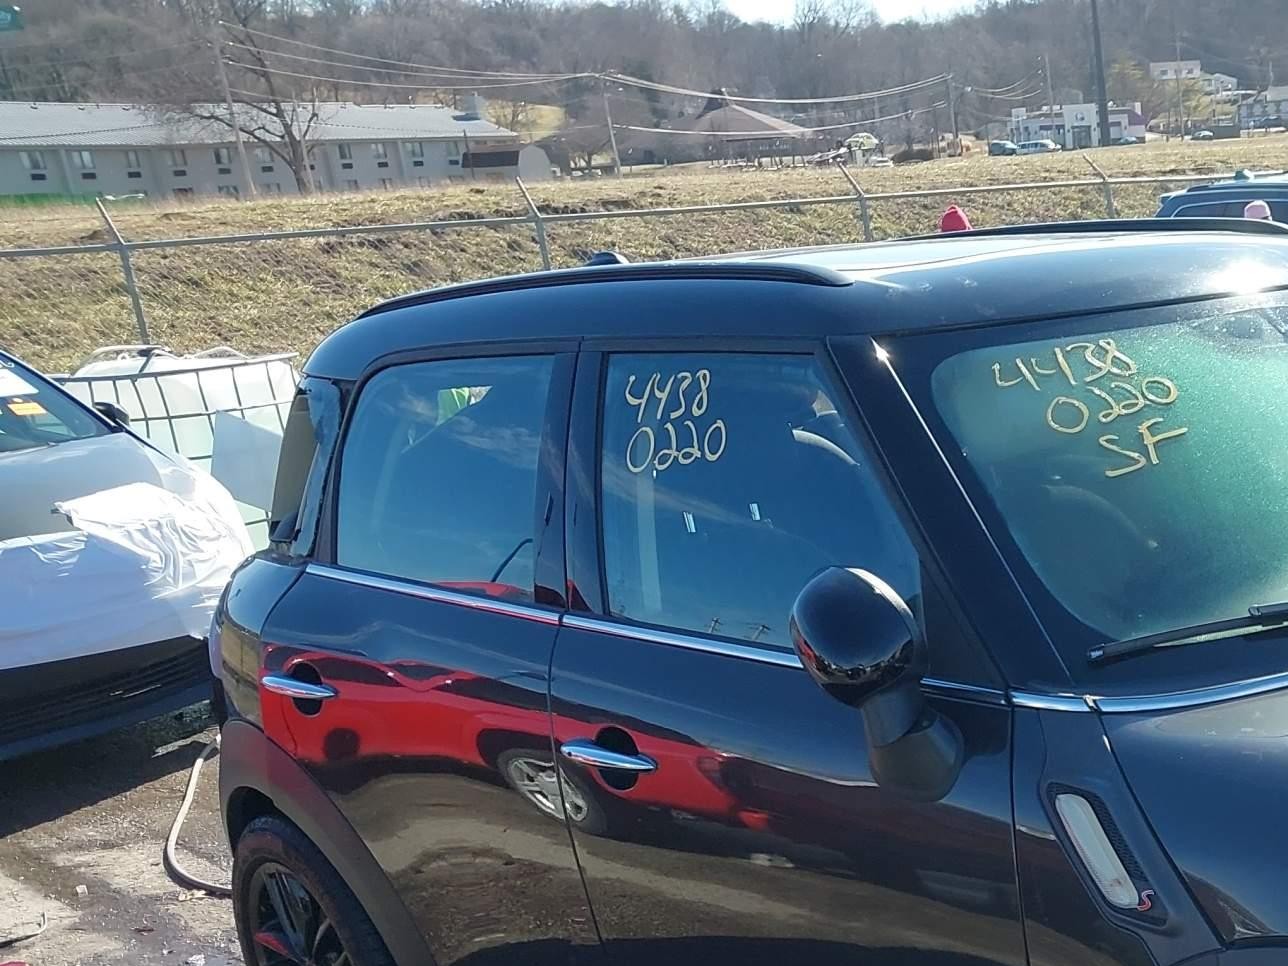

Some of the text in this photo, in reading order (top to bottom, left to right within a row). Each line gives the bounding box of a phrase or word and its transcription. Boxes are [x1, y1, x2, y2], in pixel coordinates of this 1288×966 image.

[991, 338, 1138, 391] 4438
[625, 369, 711, 424] 4438
[1046, 376, 1179, 434] 0220
[626, 419, 727, 473] 0220
[1098, 417, 1189, 478] SF
